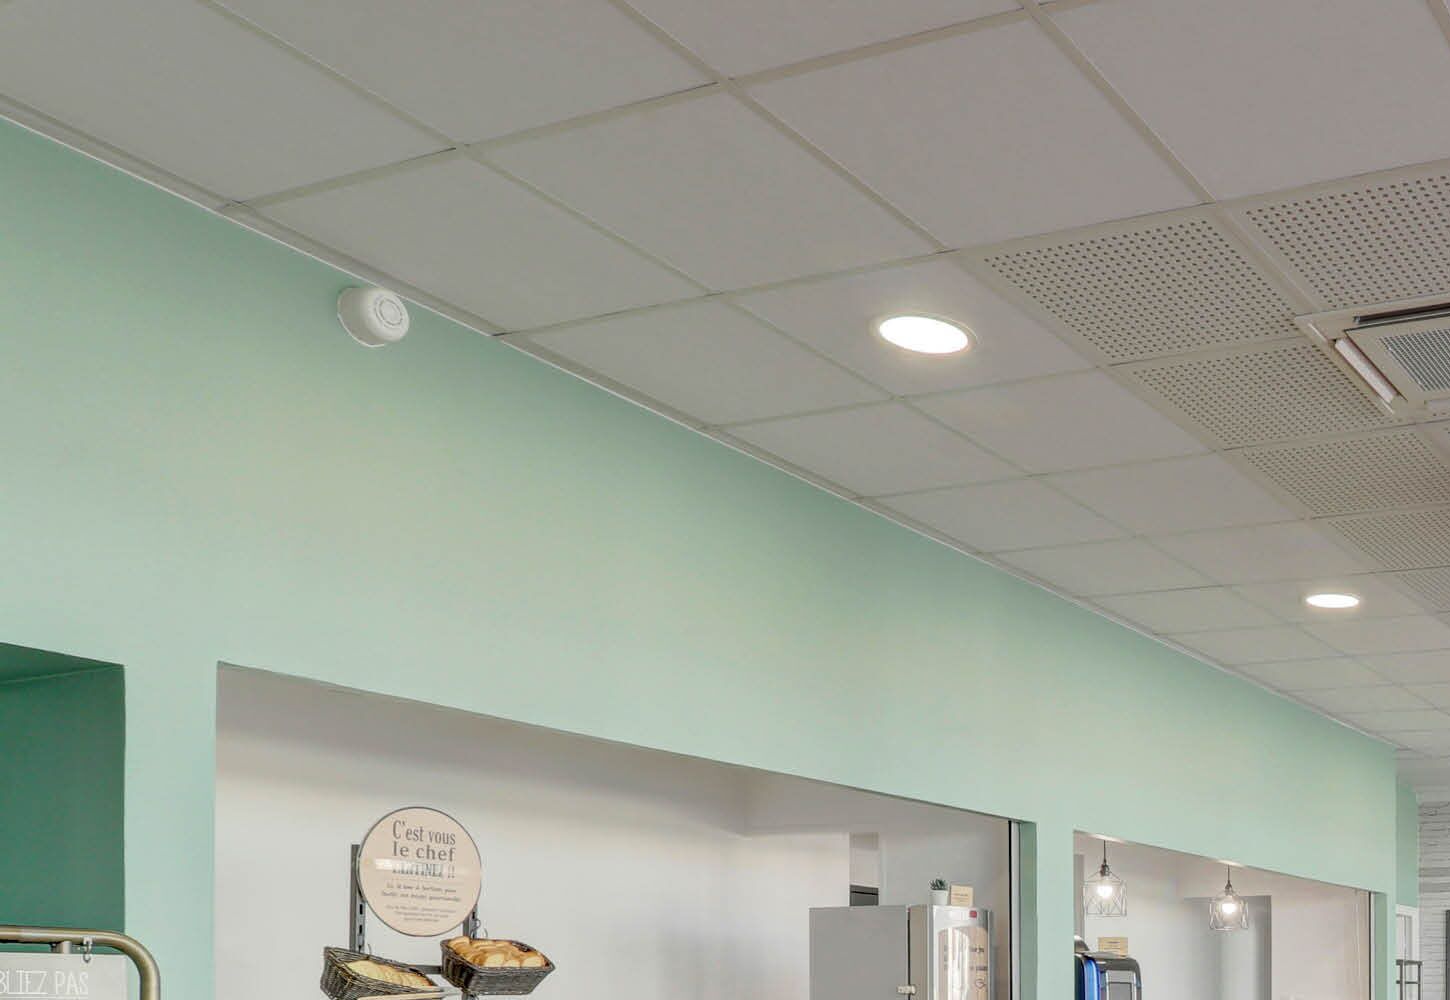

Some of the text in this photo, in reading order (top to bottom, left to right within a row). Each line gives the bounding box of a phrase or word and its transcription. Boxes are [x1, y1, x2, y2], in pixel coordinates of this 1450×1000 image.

[393, 819, 456, 846] C'est vous
[393, 840, 456, 862] le chef
[56, 970, 89, 995] PAS
